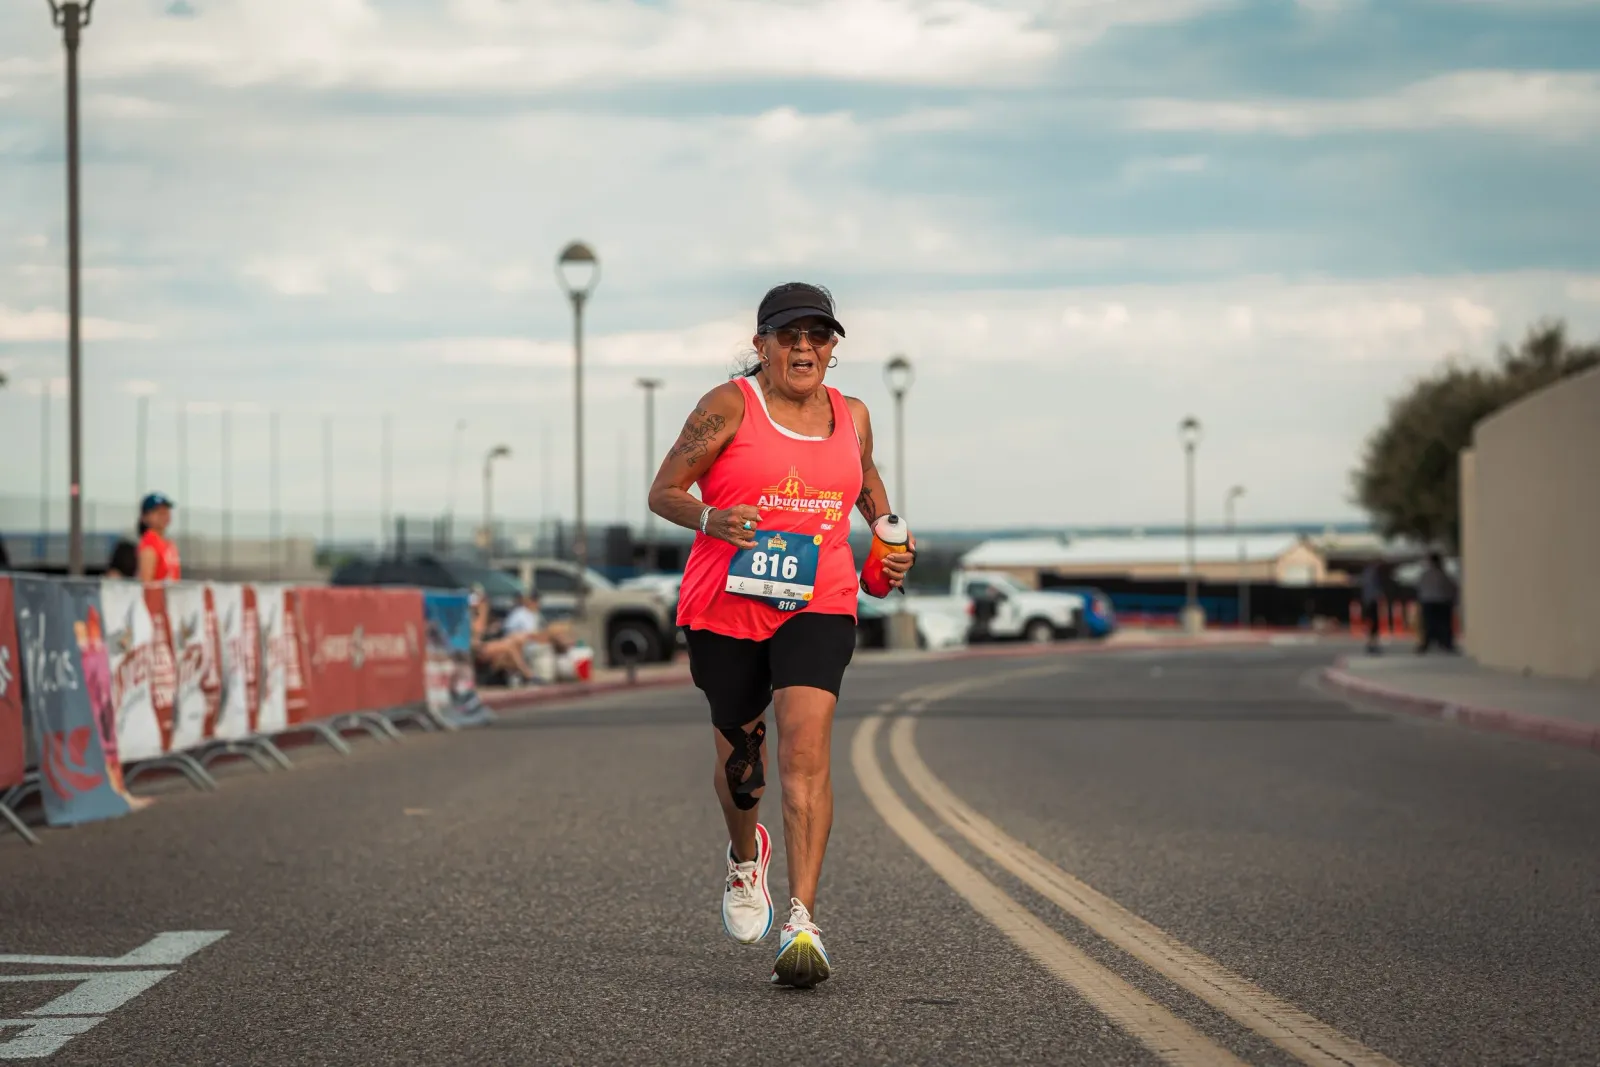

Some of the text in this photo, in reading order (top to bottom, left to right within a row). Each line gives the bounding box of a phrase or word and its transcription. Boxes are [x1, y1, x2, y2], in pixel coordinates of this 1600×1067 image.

[818, 491, 844, 500] 2025
[824, 508, 843, 521] Fit
[751, 551, 798, 579] 816
[778, 600, 796, 610] 816
